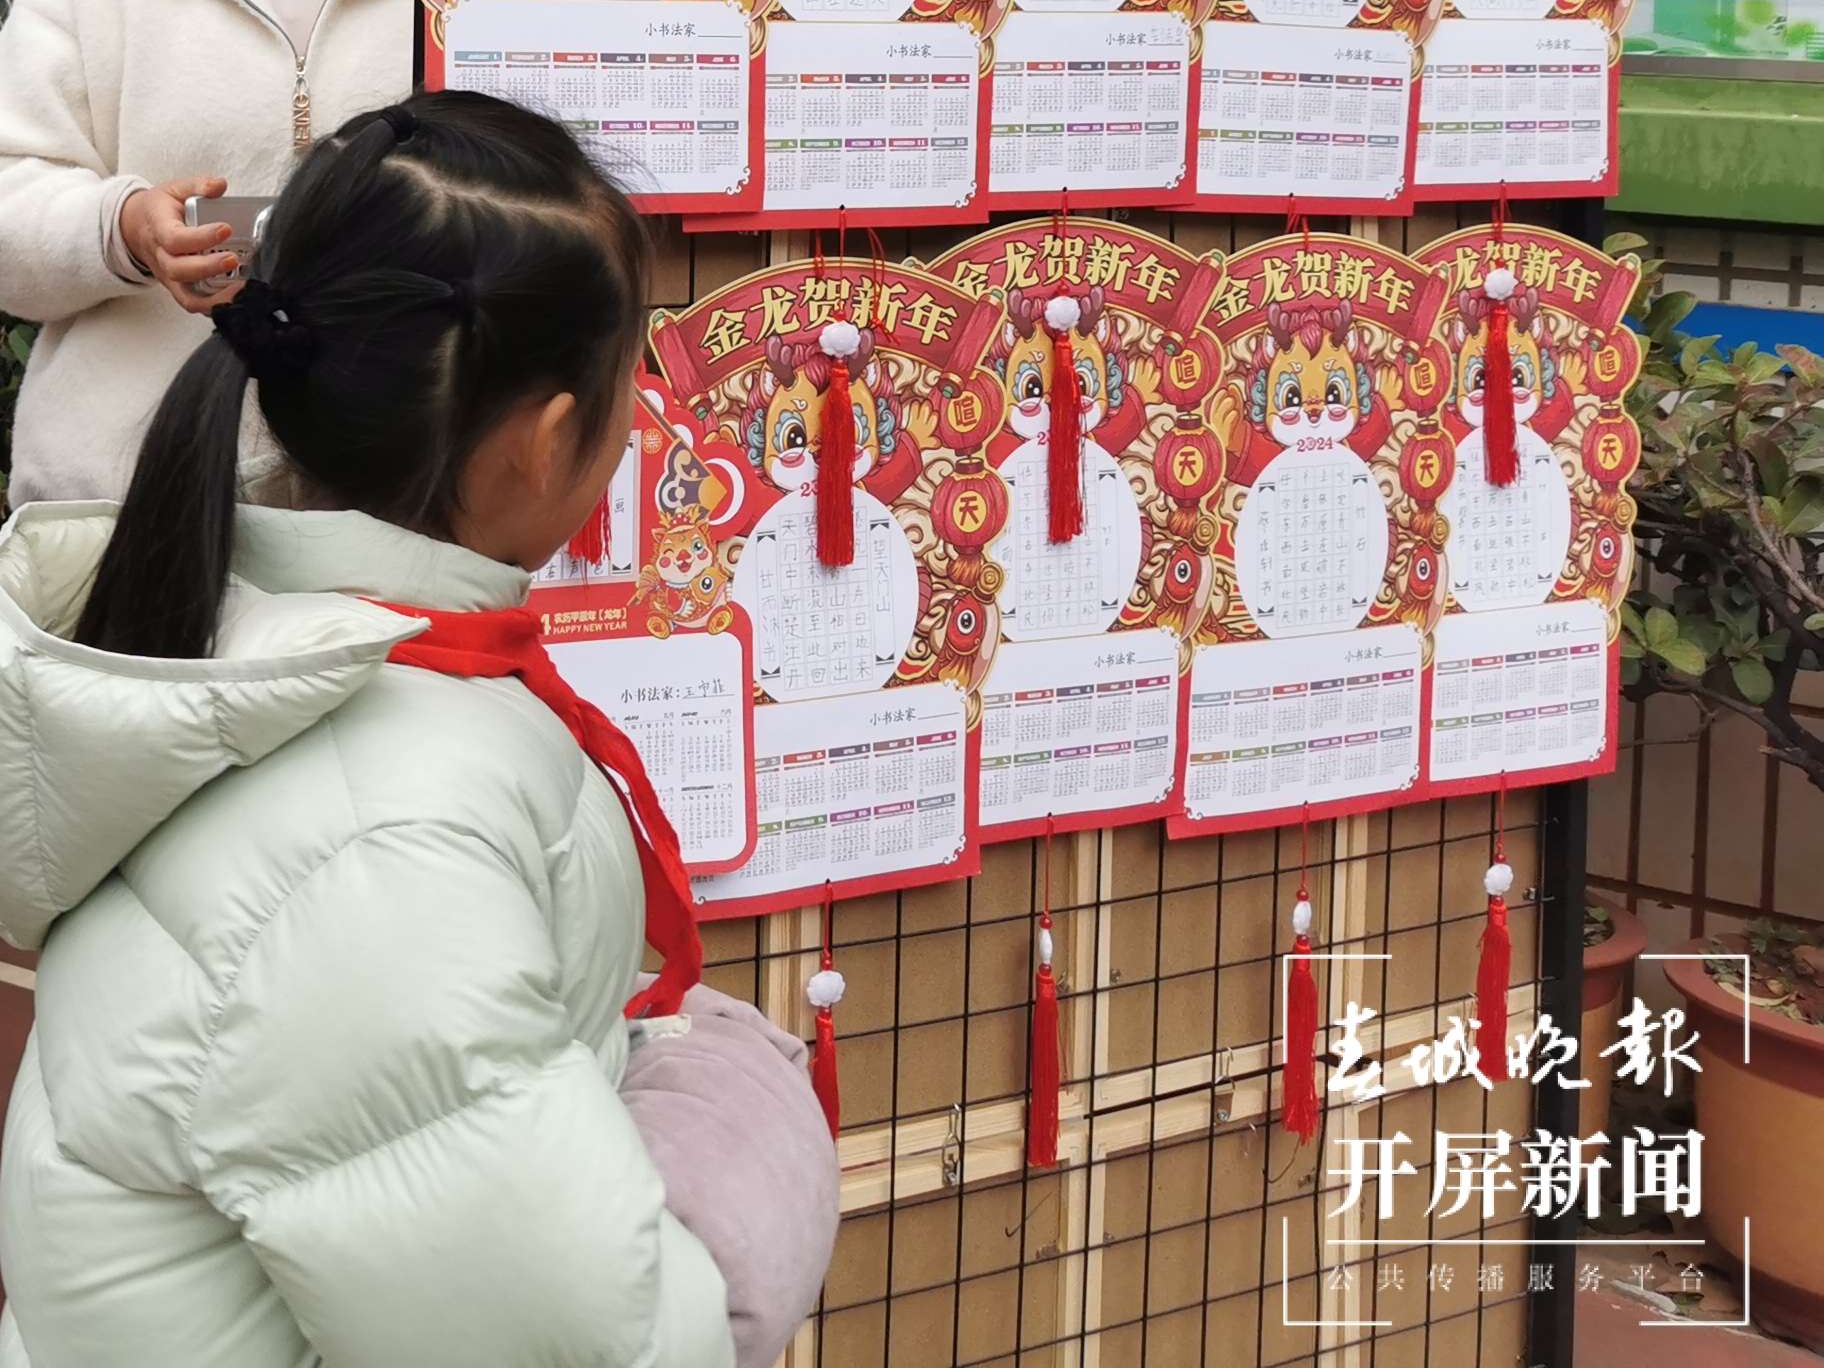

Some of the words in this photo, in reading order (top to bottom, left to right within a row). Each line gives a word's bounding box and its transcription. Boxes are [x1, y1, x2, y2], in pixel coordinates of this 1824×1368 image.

[645, 22, 697, 37] 小书法家
[1106, 33, 1147, 46] 小书法家
[887, 45, 932, 58] 小书法家
[1334, 49, 1371, 61] 小书法家
[951, 234, 1180, 303] 金龙贺新年
[1211, 251, 1415, 327] 金龙贺新年
[700, 277, 957, 365] 金龙贺新年
[1297, 437, 1333, 452] 2024
[1095, 652, 1135, 666] 小书法家
[1345, 647, 1382, 662] 小书法家
[870, 709, 915, 726] 小书法家
